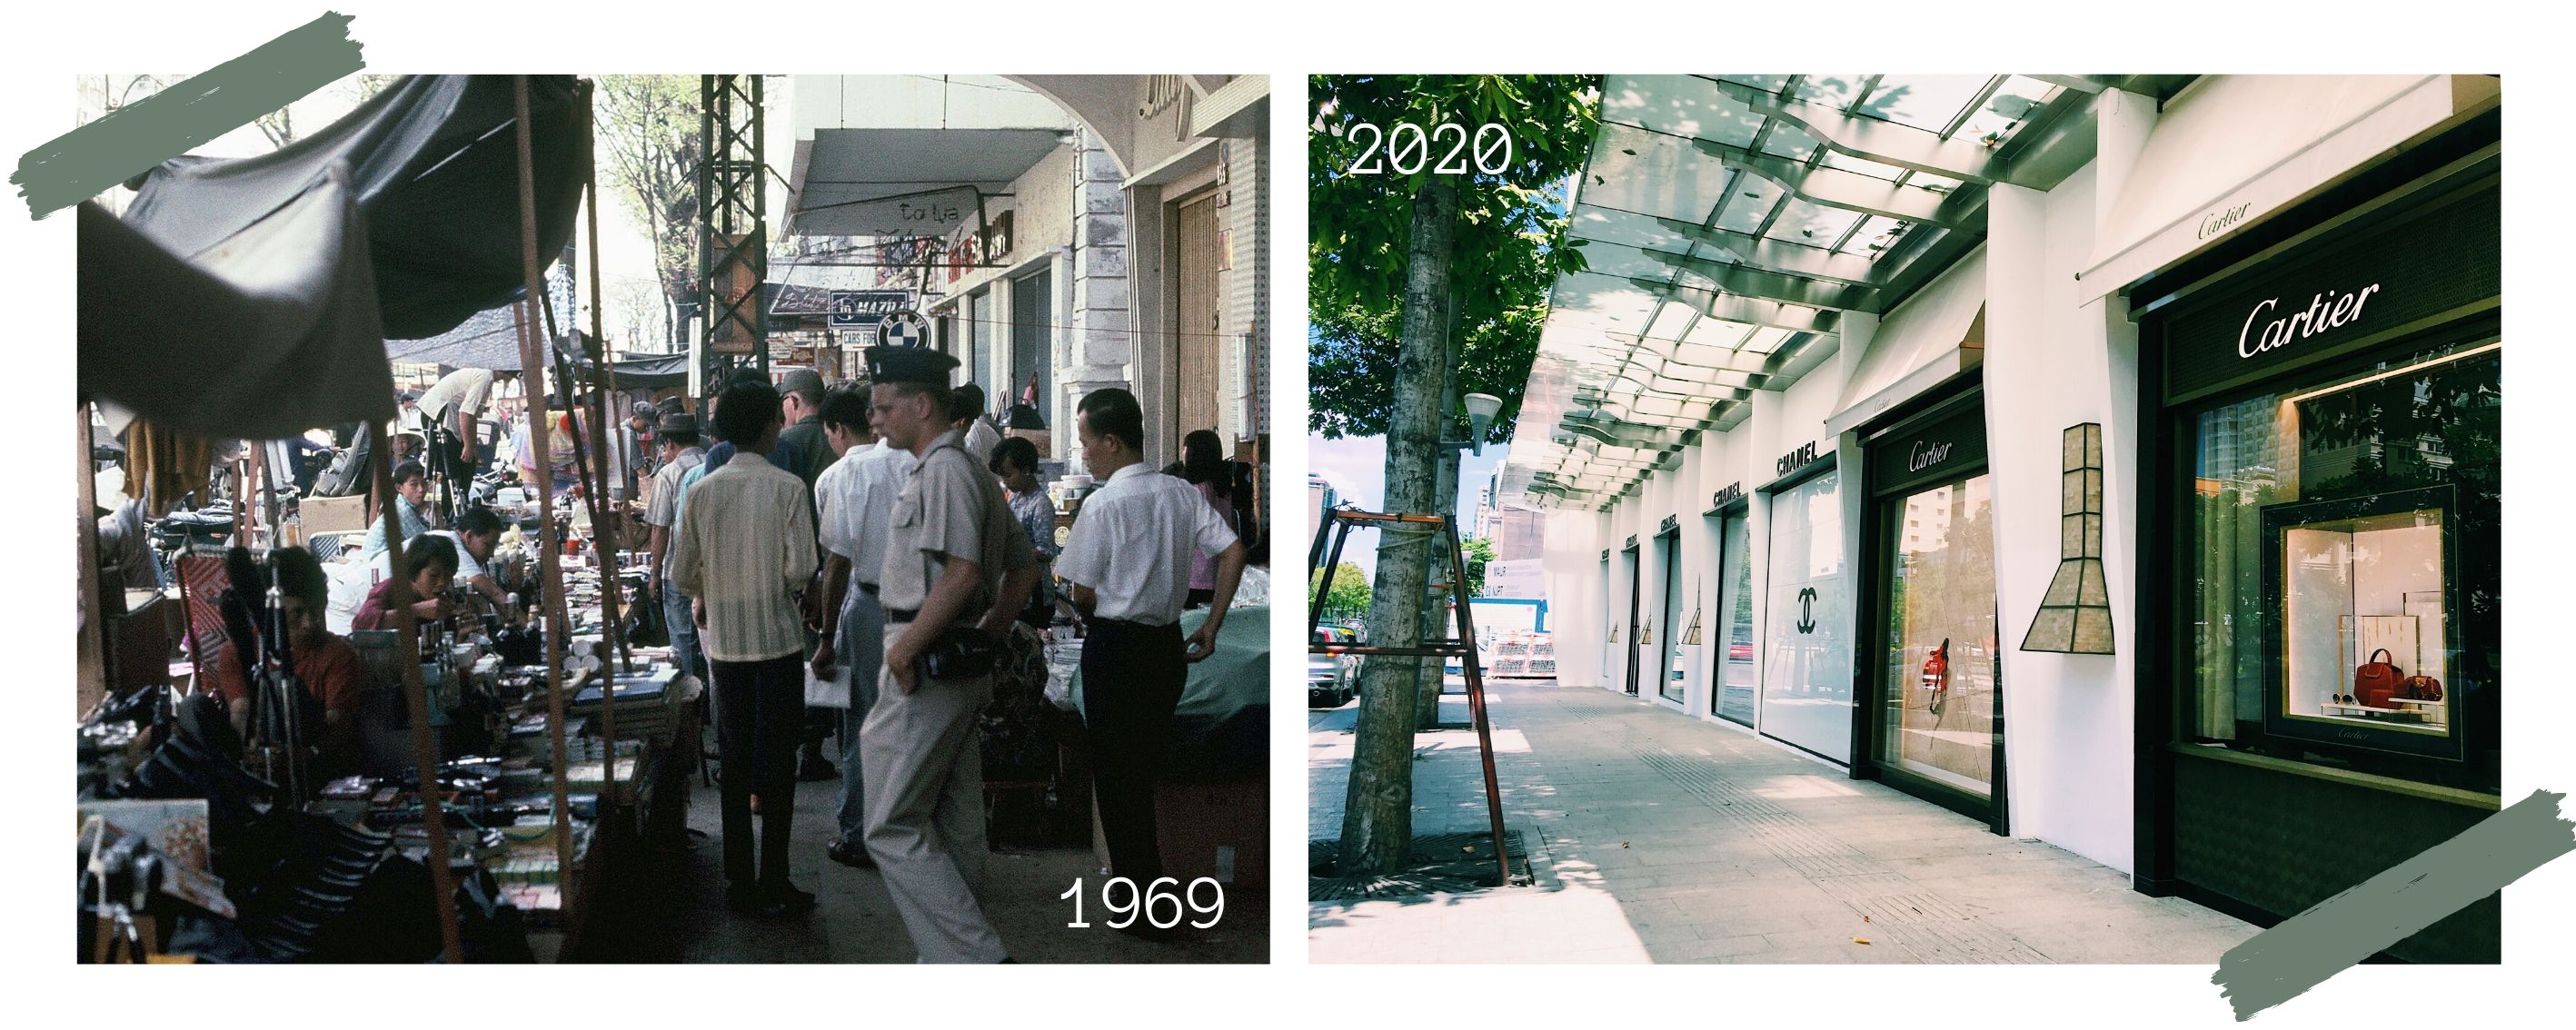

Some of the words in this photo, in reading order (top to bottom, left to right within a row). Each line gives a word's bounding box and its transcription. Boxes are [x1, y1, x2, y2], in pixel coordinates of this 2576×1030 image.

[2198, 202, 2252, 240] Cartier
[882, 314, 925, 329] BMW
[2238, 283, 2380, 359] Cartier
[843, 332, 861, 344] CARS
[1776, 440, 1818, 478] CHANEL
[1909, 441, 1953, 472] Cartier
[1713, 480, 1742, 509] CHANEL
